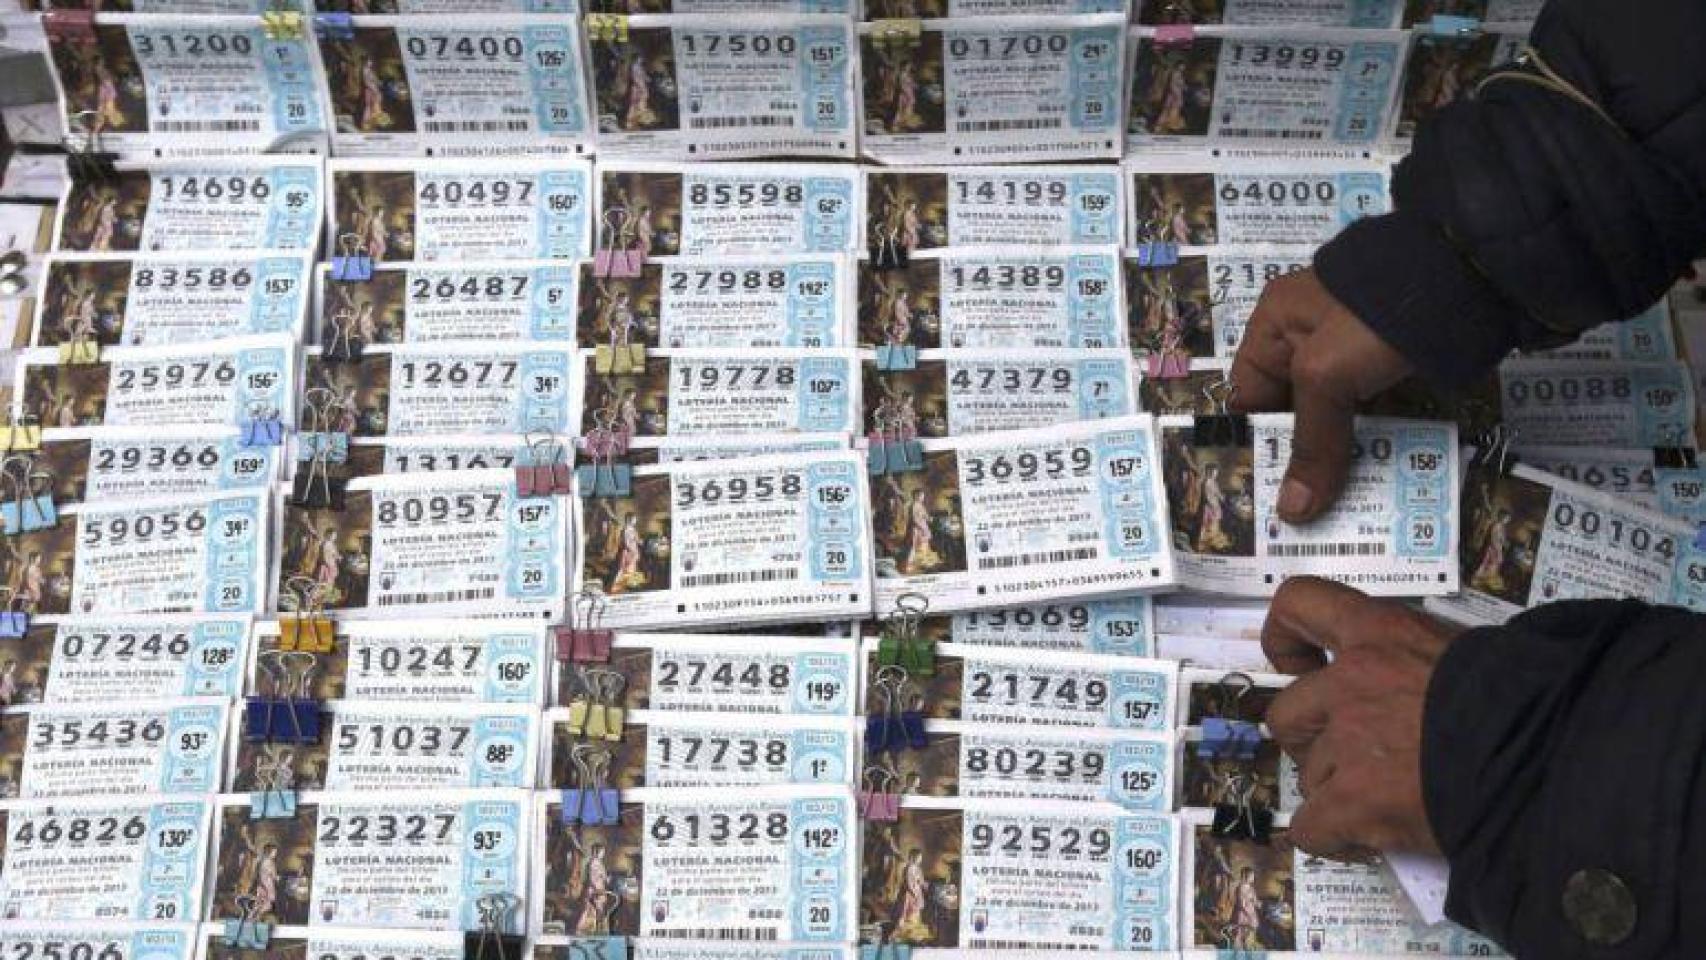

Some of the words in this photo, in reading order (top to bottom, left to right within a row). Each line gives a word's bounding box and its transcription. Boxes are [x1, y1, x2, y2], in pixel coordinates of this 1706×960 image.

[134, 34, 251, 56] 31200
[407, 36, 524, 57] 07400
[682, 35, 796, 53] 17500
[950, 35, 1067, 56] 01700
[1232, 45, 1345, 67] 13999
[160, 176, 270, 199] 14696
[420, 181, 534, 203] 40497
[690, 184, 802, 205] 85598
[956, 181, 1066, 201] 14199
[1220, 182, 1334, 201] 64000
[135, 267, 252, 288] 83586
[412, 276, 528, 299] 26487
[670, 271, 785, 289] 27988
[952, 266, 1064, 287] 14389
[116, 362, 236, 389] 25976
[401, 362, 517, 383] 12677
[679, 366, 794, 387] 19778
[951, 368, 1072, 389] 47379
[1509, 377, 1631, 401] 00088
[96, 446, 219, 469] 29366
[965, 448, 1091, 483] 36959
[676, 474, 801, 507] 36958
[378, 492, 502, 523] 80957
[84, 511, 207, 544] 59056
[1123, 525, 1142, 540] 20
[1413, 523, 1433, 539] 20
[1555, 502, 1675, 560] 00104
[826, 551, 846, 564] 20
[522, 569, 541, 583] 20
[222, 587, 240, 600] 20
[62, 633, 190, 658] 07246
[358, 647, 482, 671] 10247
[657, 662, 790, 688] 27448
[971, 671, 1108, 705] 21749
[33, 719, 165, 747] 35436
[338, 724, 470, 751] 51037
[657, 738, 787, 766] 17738
[966, 748, 1104, 778] 80239
[14, 815, 146, 845] 46826
[320, 814, 456, 842] 22327
[650, 813, 789, 841] 61328
[971, 823, 1111, 855] 92529
[155, 903, 176, 919] 20
[810, 908, 829, 923] 20
[1132, 926, 1151, 942] 20
